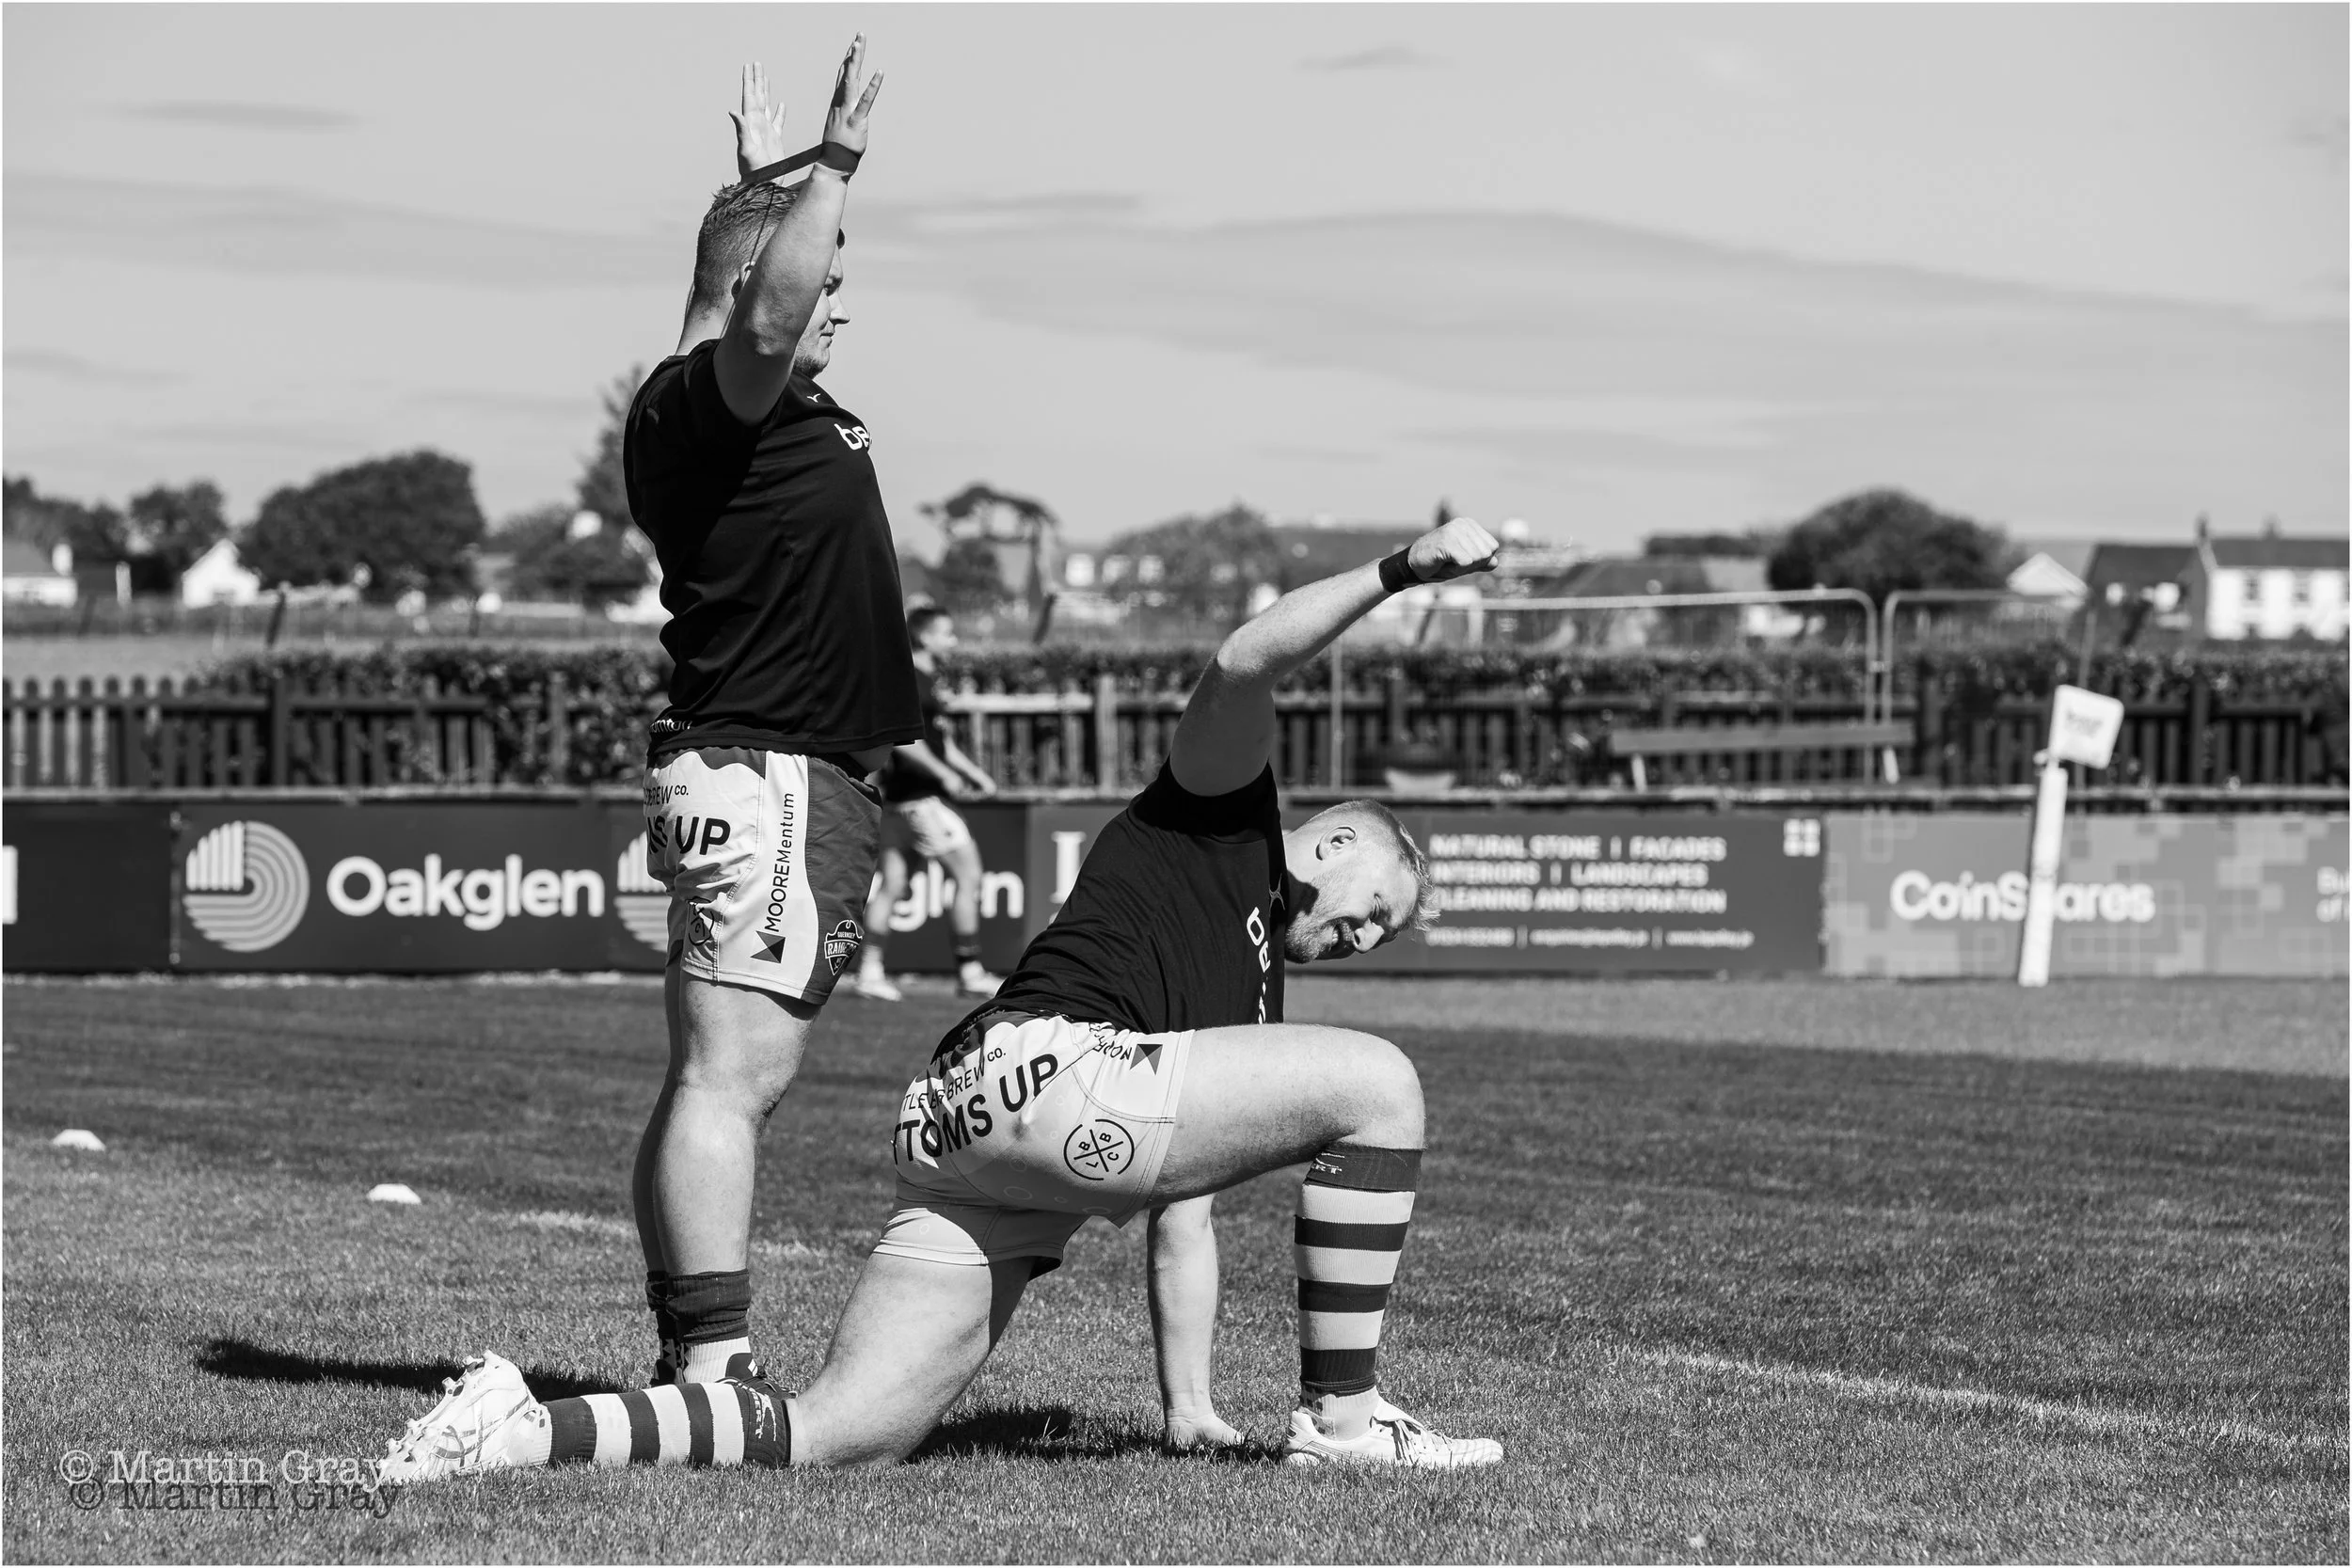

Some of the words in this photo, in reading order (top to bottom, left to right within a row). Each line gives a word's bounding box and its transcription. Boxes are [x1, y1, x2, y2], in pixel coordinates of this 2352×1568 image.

[674, 784, 689, 796] CO.
[675, 816, 731, 855] UP
[764, 793, 794, 932] MOOREMentum
[1430, 833, 1528, 859] NATURAL
[1530, 834, 1601, 860] STONE
[326, 853, 604, 931] Oakglen
[1534, 887, 1580, 911] AND
[1581, 888, 1727, 913] RESTORATION
[1889, 869, 2156, 923] CoinSares
[946, 1057, 985, 1101] BREW
[987, 1047, 1007, 1062] CO.
[999, 1053, 1059, 1113] UP
